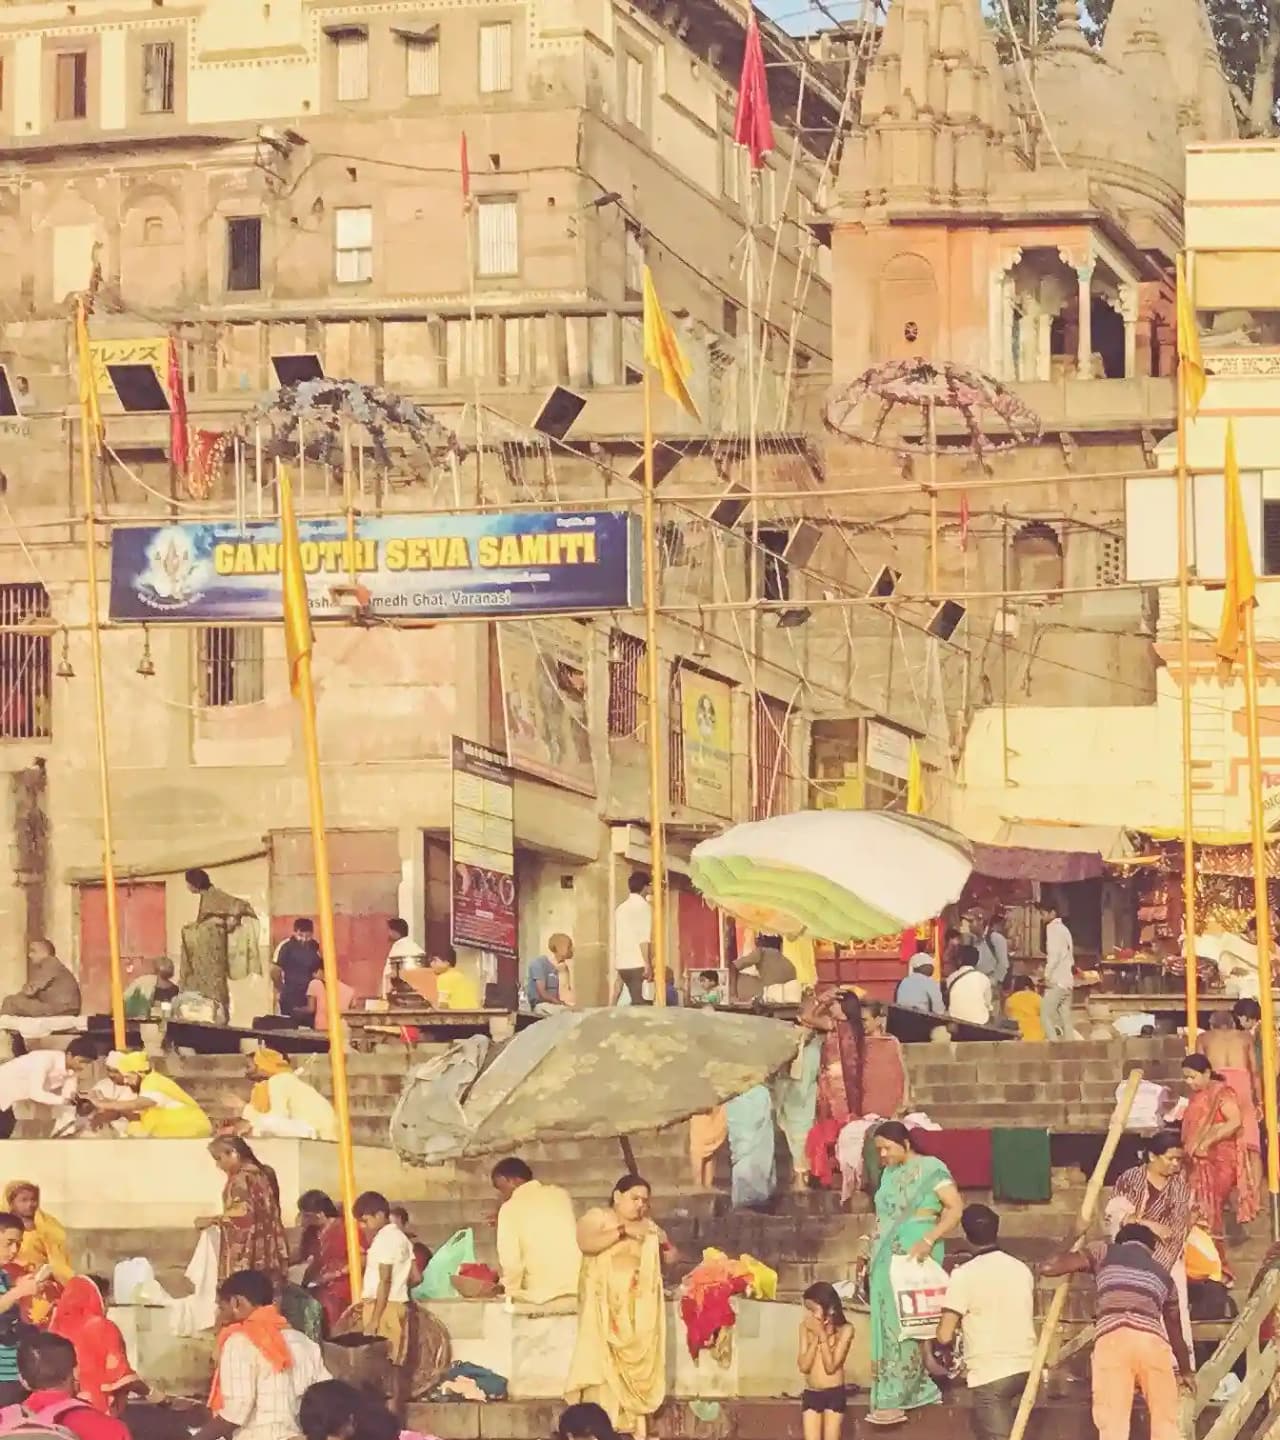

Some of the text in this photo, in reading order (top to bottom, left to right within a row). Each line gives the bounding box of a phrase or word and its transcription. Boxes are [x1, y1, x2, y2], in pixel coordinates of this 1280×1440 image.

[385, 536, 472, 571] SEVA
[478, 531, 597, 568] SAMITI
[412, 592, 448, 608] Ghat,
[452, 589, 512, 606] Varanasi
